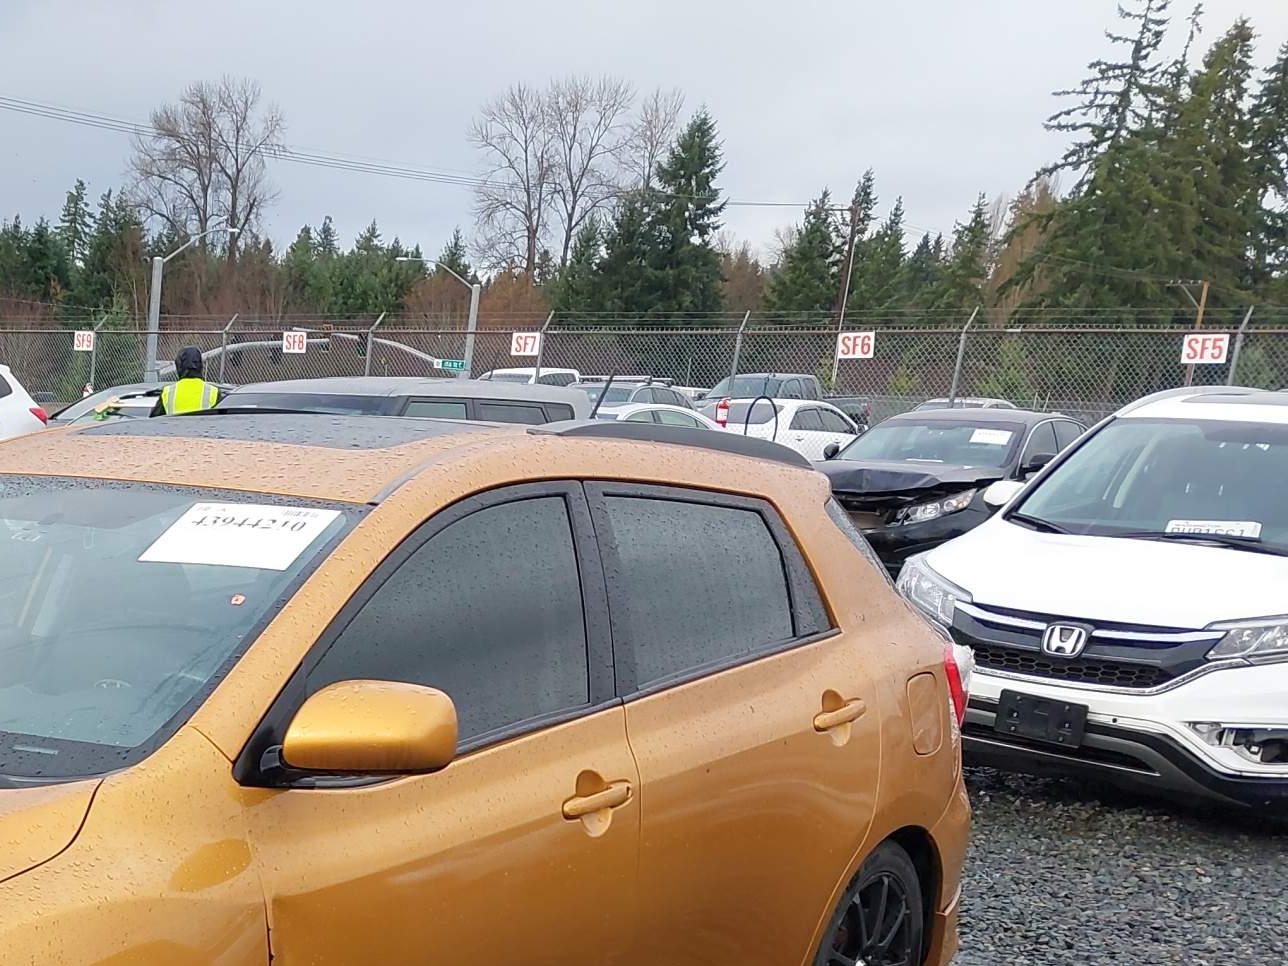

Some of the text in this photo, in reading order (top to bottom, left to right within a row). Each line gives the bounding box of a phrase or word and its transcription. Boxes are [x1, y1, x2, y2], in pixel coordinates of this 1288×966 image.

[76, 333, 92, 348] SF9
[285, 334, 304, 350] SF8
[515, 335, 537, 352] SF7
[841, 335, 871, 355] SF6
[1186, 337, 1225, 360] SF5
